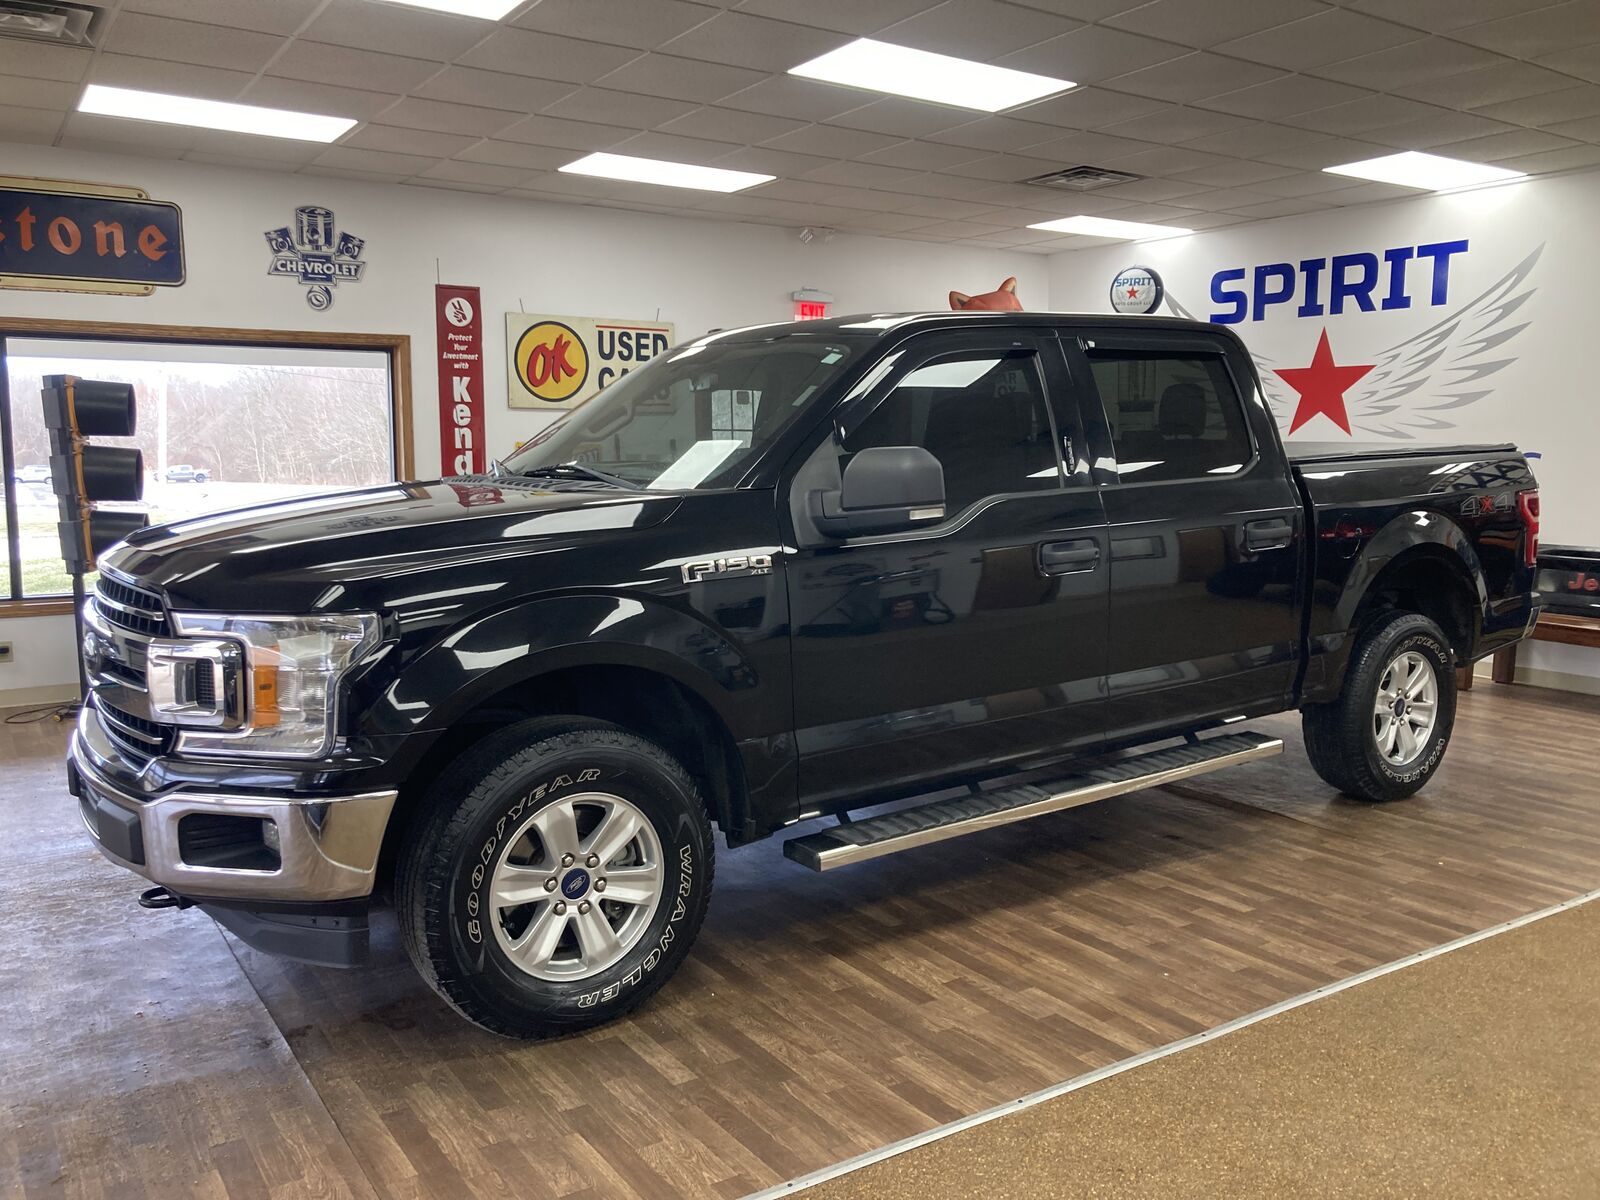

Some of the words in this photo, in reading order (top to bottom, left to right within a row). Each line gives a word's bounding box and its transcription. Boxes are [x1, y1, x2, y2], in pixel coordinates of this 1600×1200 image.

[0, 206, 168, 261] tone
[276, 260, 357, 276] CHEVROLET
[1115, 277, 1151, 287] SPIRIT
[1210, 239, 1469, 325] SPIRIT
[801, 303, 824, 317] EXIT
[448, 333, 472, 342] Protect
[454, 343, 468, 351] Your
[598, 330, 668, 361] USED
[454, 362, 469, 370] with
[527, 334, 578, 387] OK
[467, 768, 600, 943] GOODYEAR
[578, 844, 692, 1008] WRANGLER
